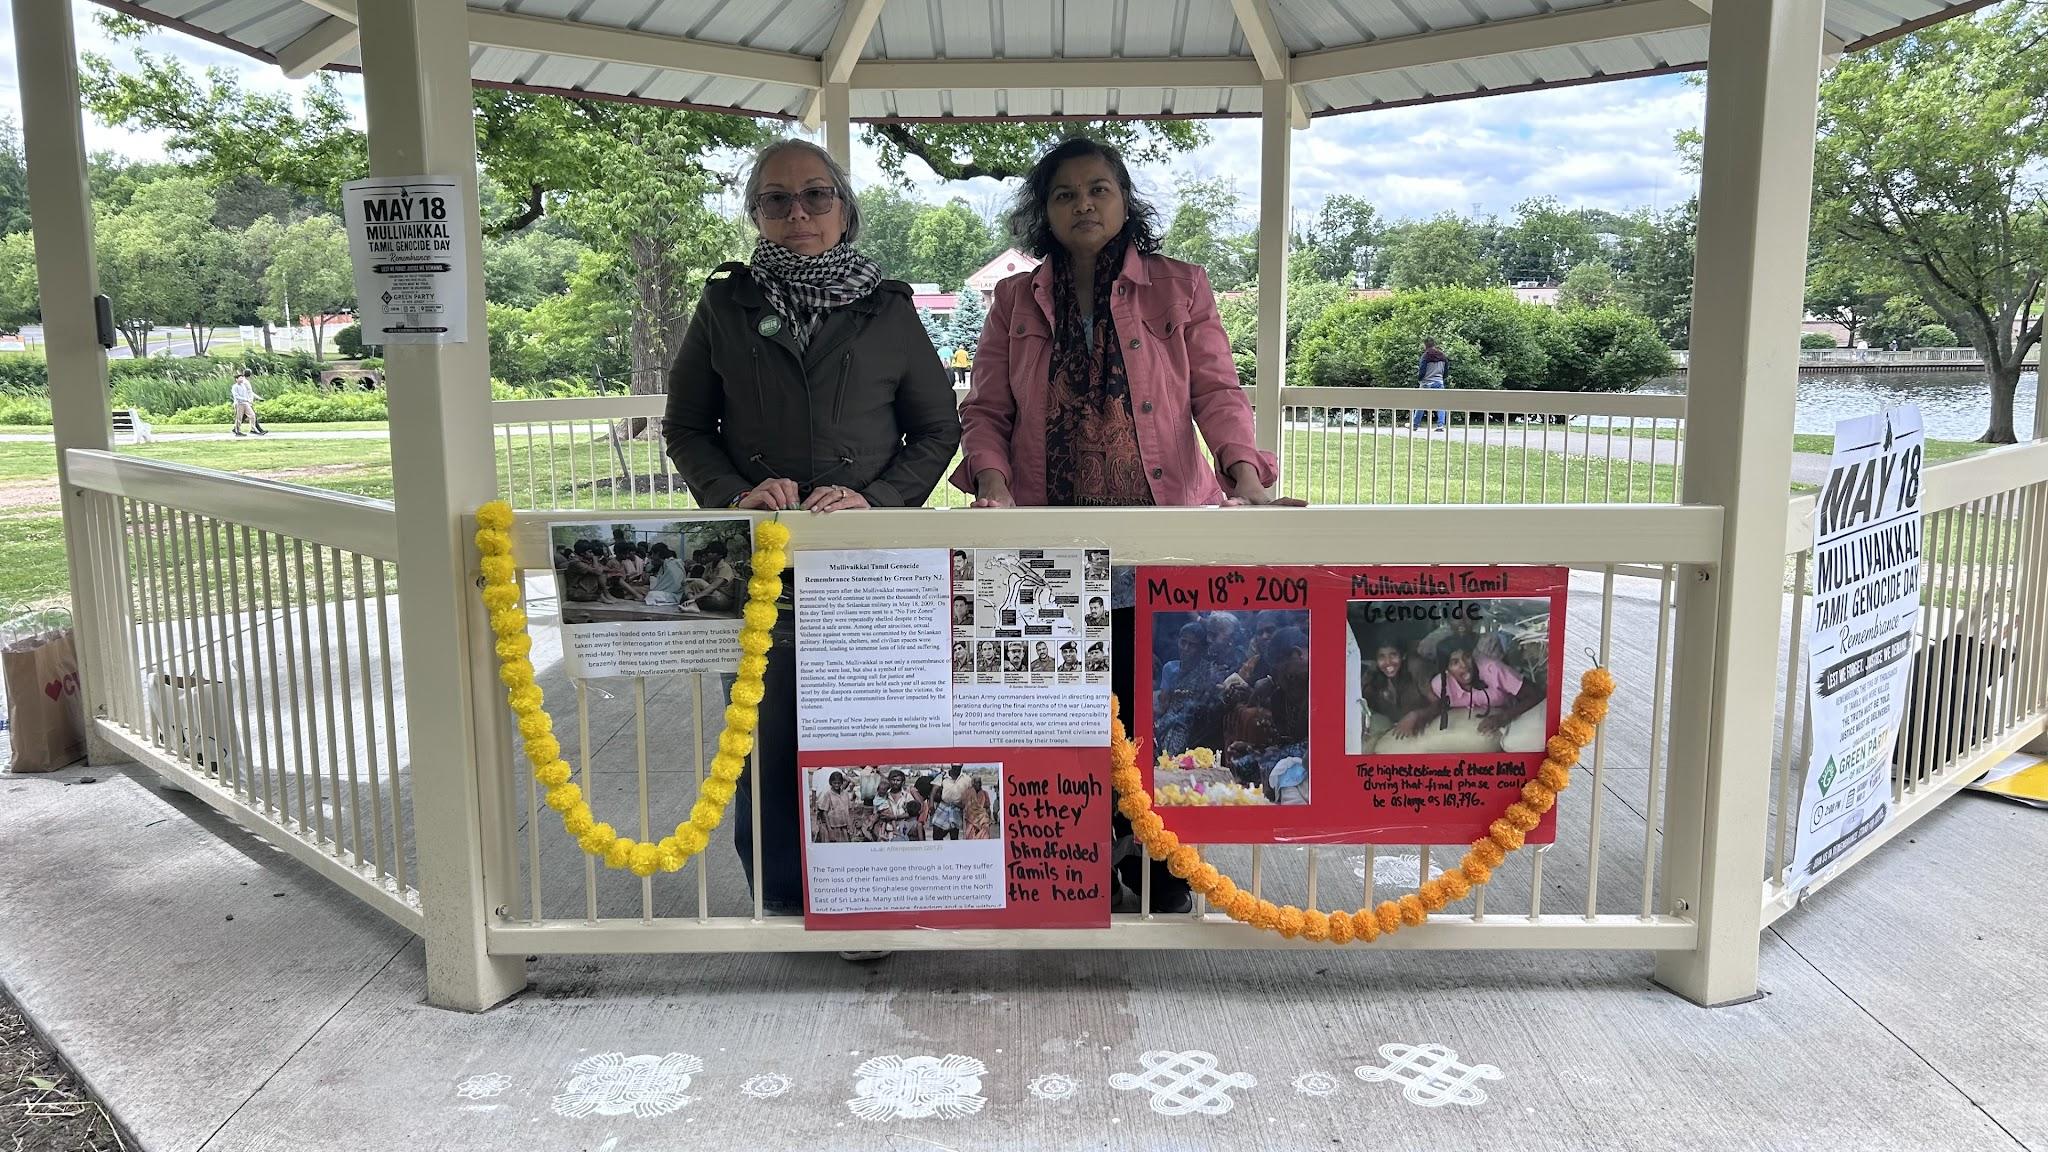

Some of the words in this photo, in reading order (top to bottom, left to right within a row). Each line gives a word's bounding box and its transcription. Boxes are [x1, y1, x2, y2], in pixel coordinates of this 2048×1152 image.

[364, 198, 413, 221] MAY
[419, 197, 446, 220] 18
[366, 224, 450, 240] MULLIVAIKKAL
[368, 242, 394, 252] TAMIL
[396, 240, 430, 251] GENOCIDE
[434, 240, 450, 250] DAY
[389, 253, 431, 262] Remembrance
[1820, 452, 1897, 536] MAY
[1896, 444, 1921, 512] 18
[1818, 519, 1919, 595] MULLIVAIKKAL
[915, 574, 931, 582] Party
[1352, 573, 1455, 596] Mullivaikkal
[1459, 571, 1508, 592] Tamil
[1148, 578, 1198, 610] May
[1256, 576, 1307, 606] 2009
[1816, 593, 1848, 633] TAMIL
[1852, 571, 1901, 618] GENOCIDE
[1904, 563, 1919, 597] DAY
[1364, 600, 1483, 622] Genocide
[1840, 613, 1900, 654] Remembrance
[1839, 743, 1866, 774] GREEN
[1356, 763, 1374, 777] The
[1376, 764, 1412, 780] highest
[1453, 760, 1465, 776] of
[1008, 774, 1049, 797] Some
[1057, 773, 1102, 809] laugh
[1363, 778, 1400, 793] during
[1401, 779, 1422, 790] that
[1424, 778, 1452, 791] final
[1457, 779, 1490, 791] phase
[1009, 802, 1030, 818] as
[1034, 798, 1082, 826] they
[1373, 794, 1386, 808] be
[1391, 796, 1402, 807] as
[1403, 794, 1426, 813] large
[1427, 795, 1440, 807] as
[1008, 819, 1065, 839] shoot
[908, 864, 935, 872] through
[955, 863, 971, 871] They
[1007, 861, 1059, 881] Tamils
[1066, 865, 1083, 884] in
[953, 893, 992, 901] uncertainty
[1008, 882, 1040, 902] the
[1052, 883, 1105, 902] head.
